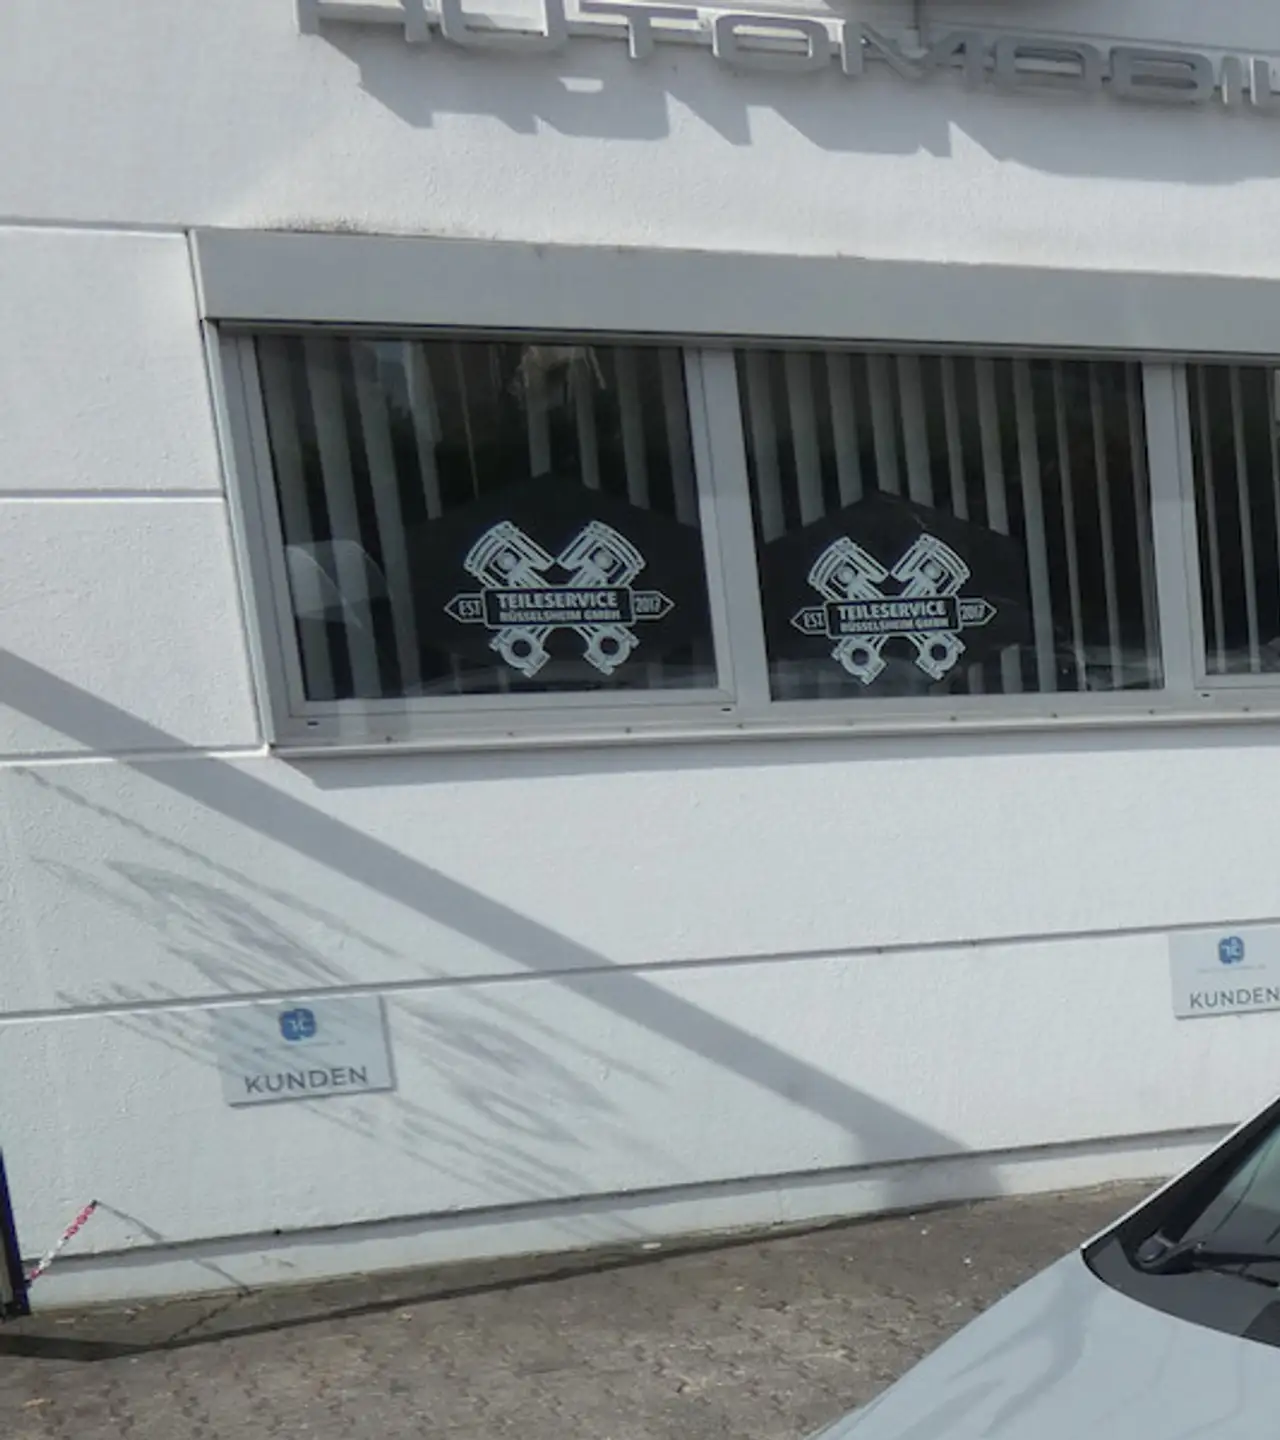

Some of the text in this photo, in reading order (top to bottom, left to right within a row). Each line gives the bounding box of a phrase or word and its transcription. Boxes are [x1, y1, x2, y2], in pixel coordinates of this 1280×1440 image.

[458, 599, 481, 616] EST
[496, 590, 618, 609] TEILESERVICE
[838, 600, 947, 621] TEILESERVICE
[1189, 986, 1280, 1010] KUNDEN
[244, 1065, 369, 1095] KUNDEN
